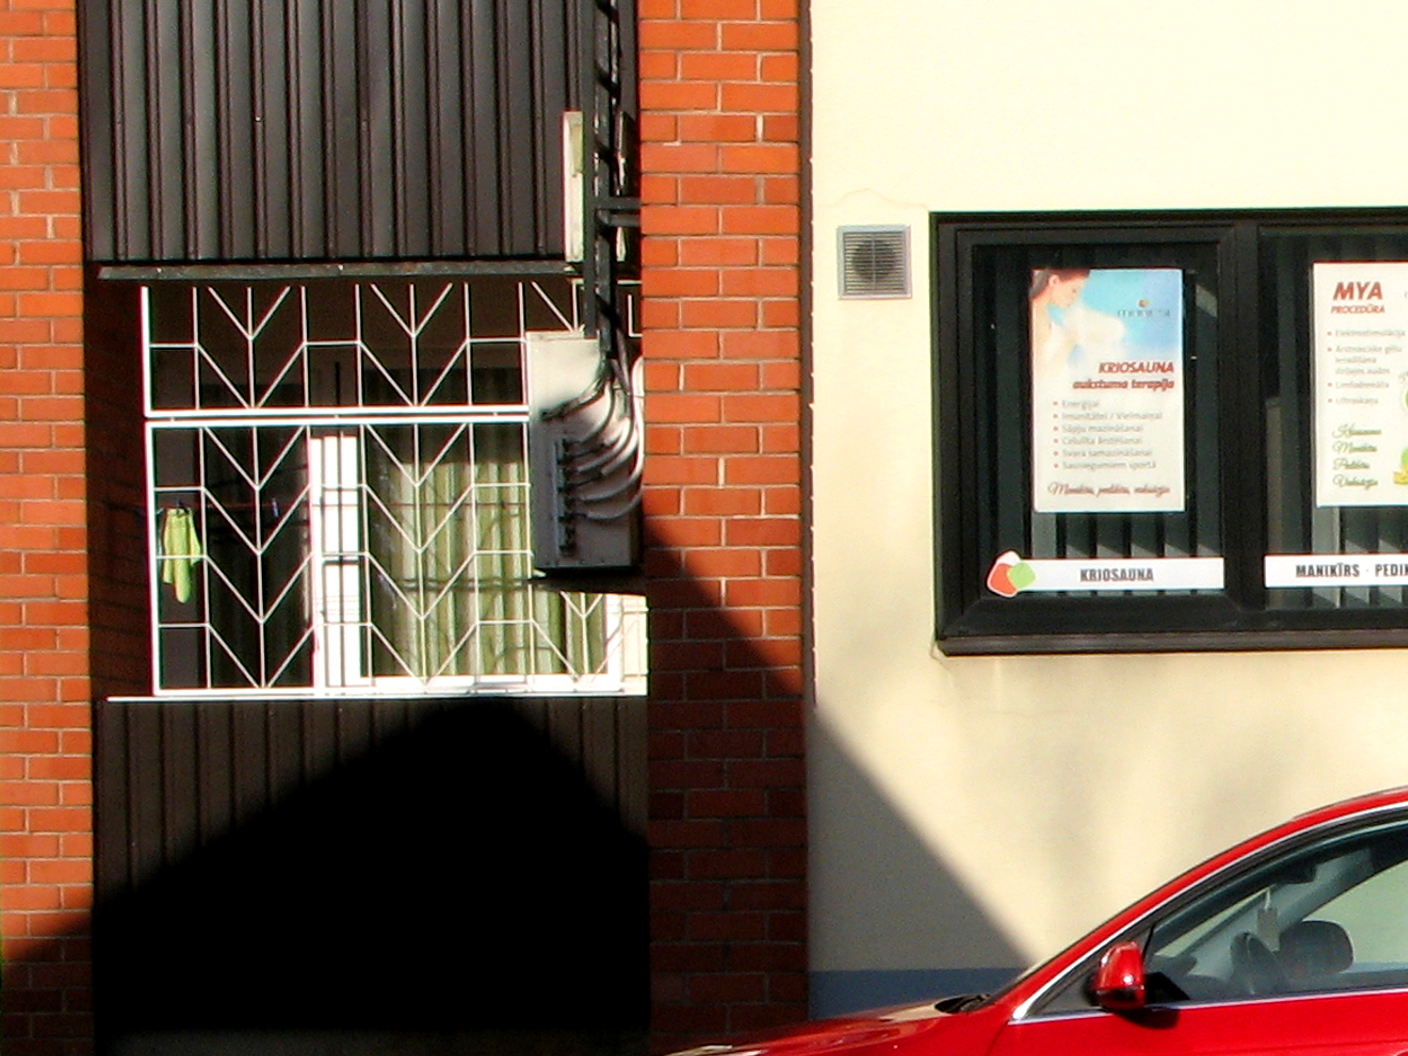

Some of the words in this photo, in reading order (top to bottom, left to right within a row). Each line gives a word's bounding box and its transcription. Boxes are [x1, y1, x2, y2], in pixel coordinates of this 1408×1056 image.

[1333, 282, 1383, 300] MYA
[1331, 303, 1385, 314] PROCEDŪRA
[1099, 362, 1174, 373] KRIOSAUNA
[1080, 568, 1154, 582] KRIOSAUNA
[1296, 562, 1360, 578] MANIKĪRS
